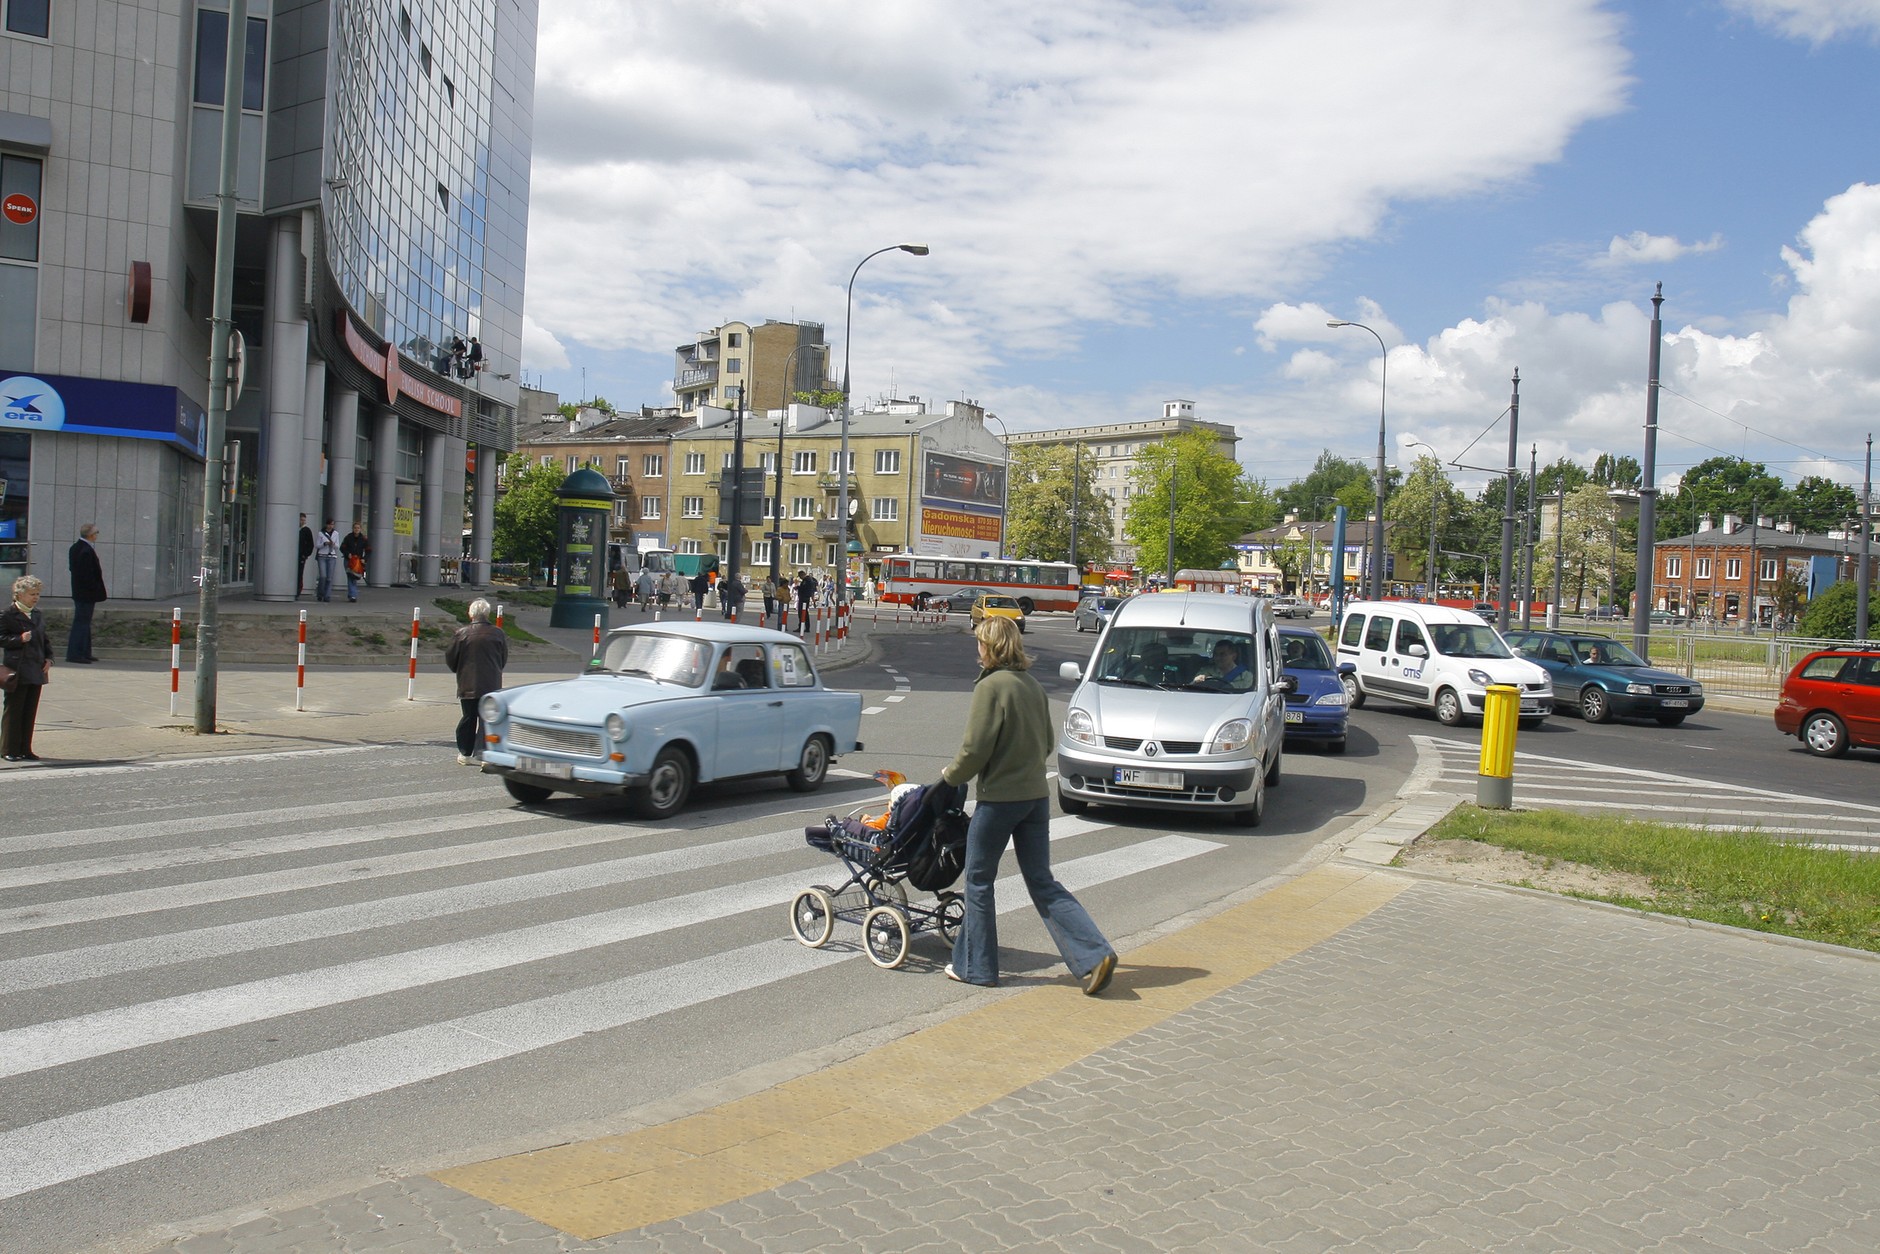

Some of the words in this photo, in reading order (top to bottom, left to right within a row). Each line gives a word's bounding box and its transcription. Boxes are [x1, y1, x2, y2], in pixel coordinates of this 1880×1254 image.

[401, 374, 424, 400] ENGLISH
[427, 389, 455, 414] SCHOOL
[4, 411, 43, 422] era
[923, 509, 975, 524] Gadomska
[922, 520, 976, 539] Nieruchomości
[1403, 667, 1421, 679] OTIS
[1123, 770, 1141, 782] WF
